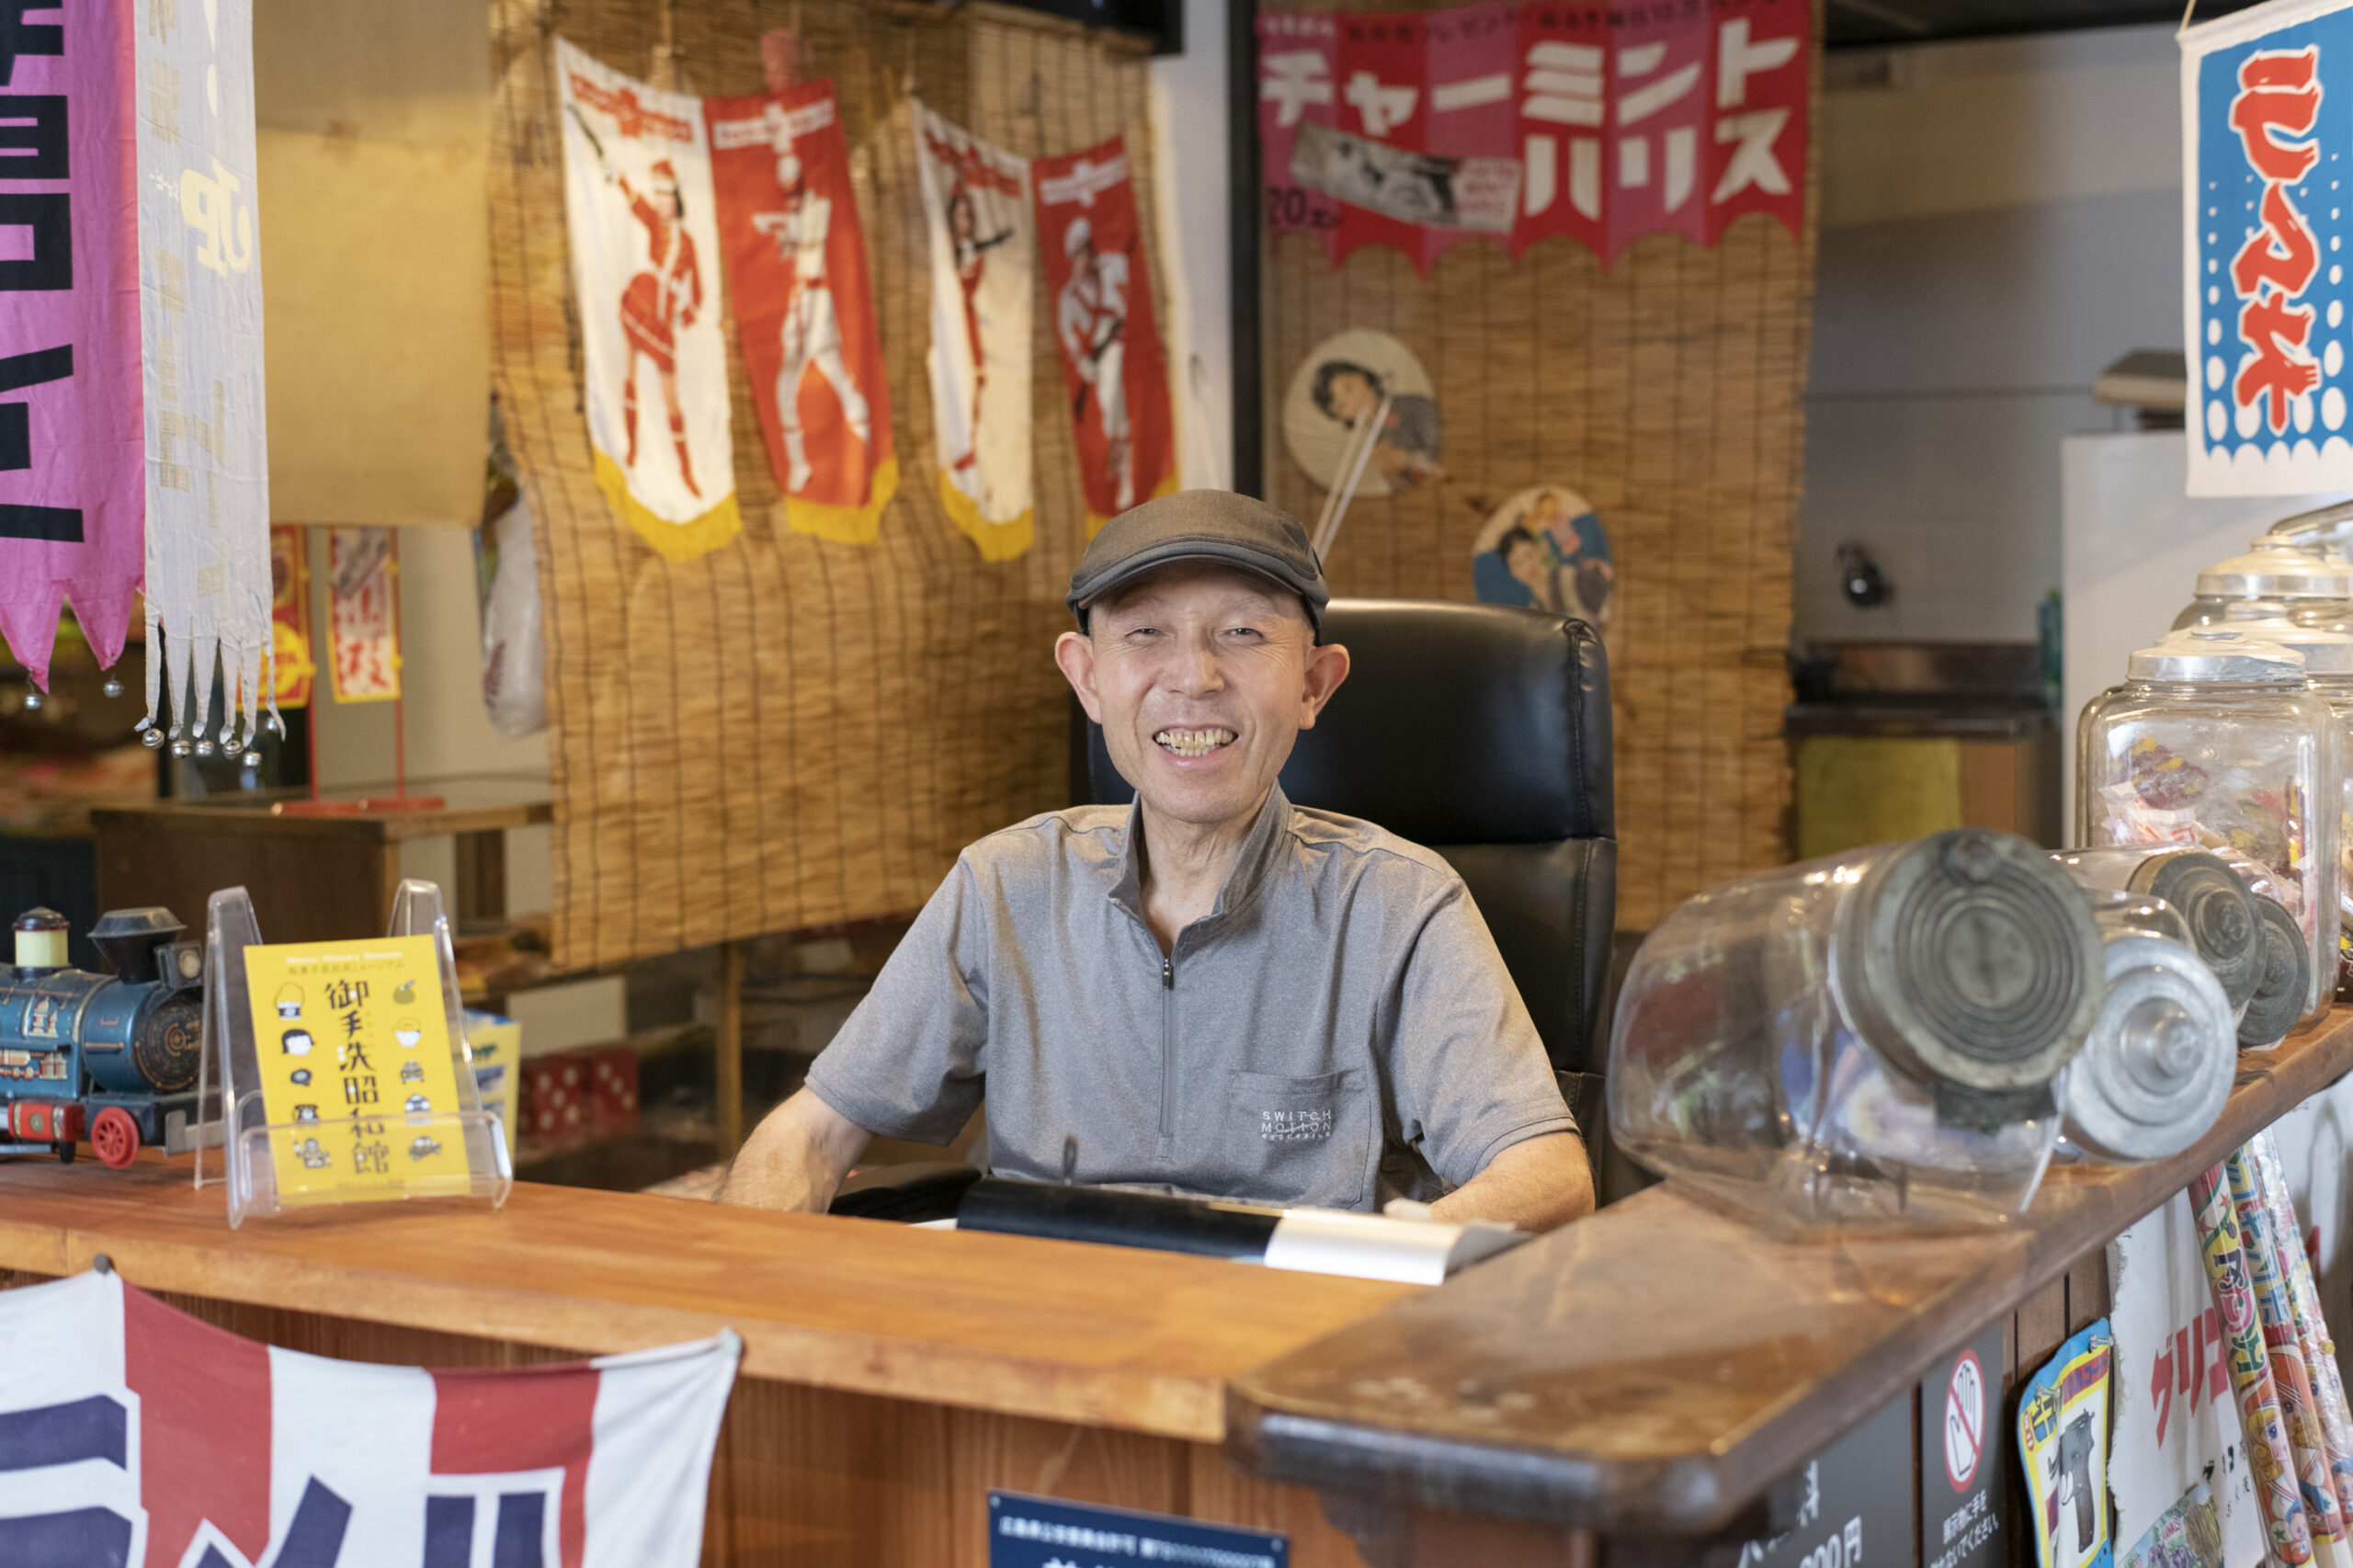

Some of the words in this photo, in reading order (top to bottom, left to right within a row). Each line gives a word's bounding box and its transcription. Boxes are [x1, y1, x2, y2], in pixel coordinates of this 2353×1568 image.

[1259, 17, 1801, 137] チャーミント
[1520, 109, 1793, 222] ハリス
[324, 980, 390, 1174] 御手洗昭和館
[1261, 1121, 1331, 1133] MOTION
[1263, 1109, 1331, 1122] SWITCH
